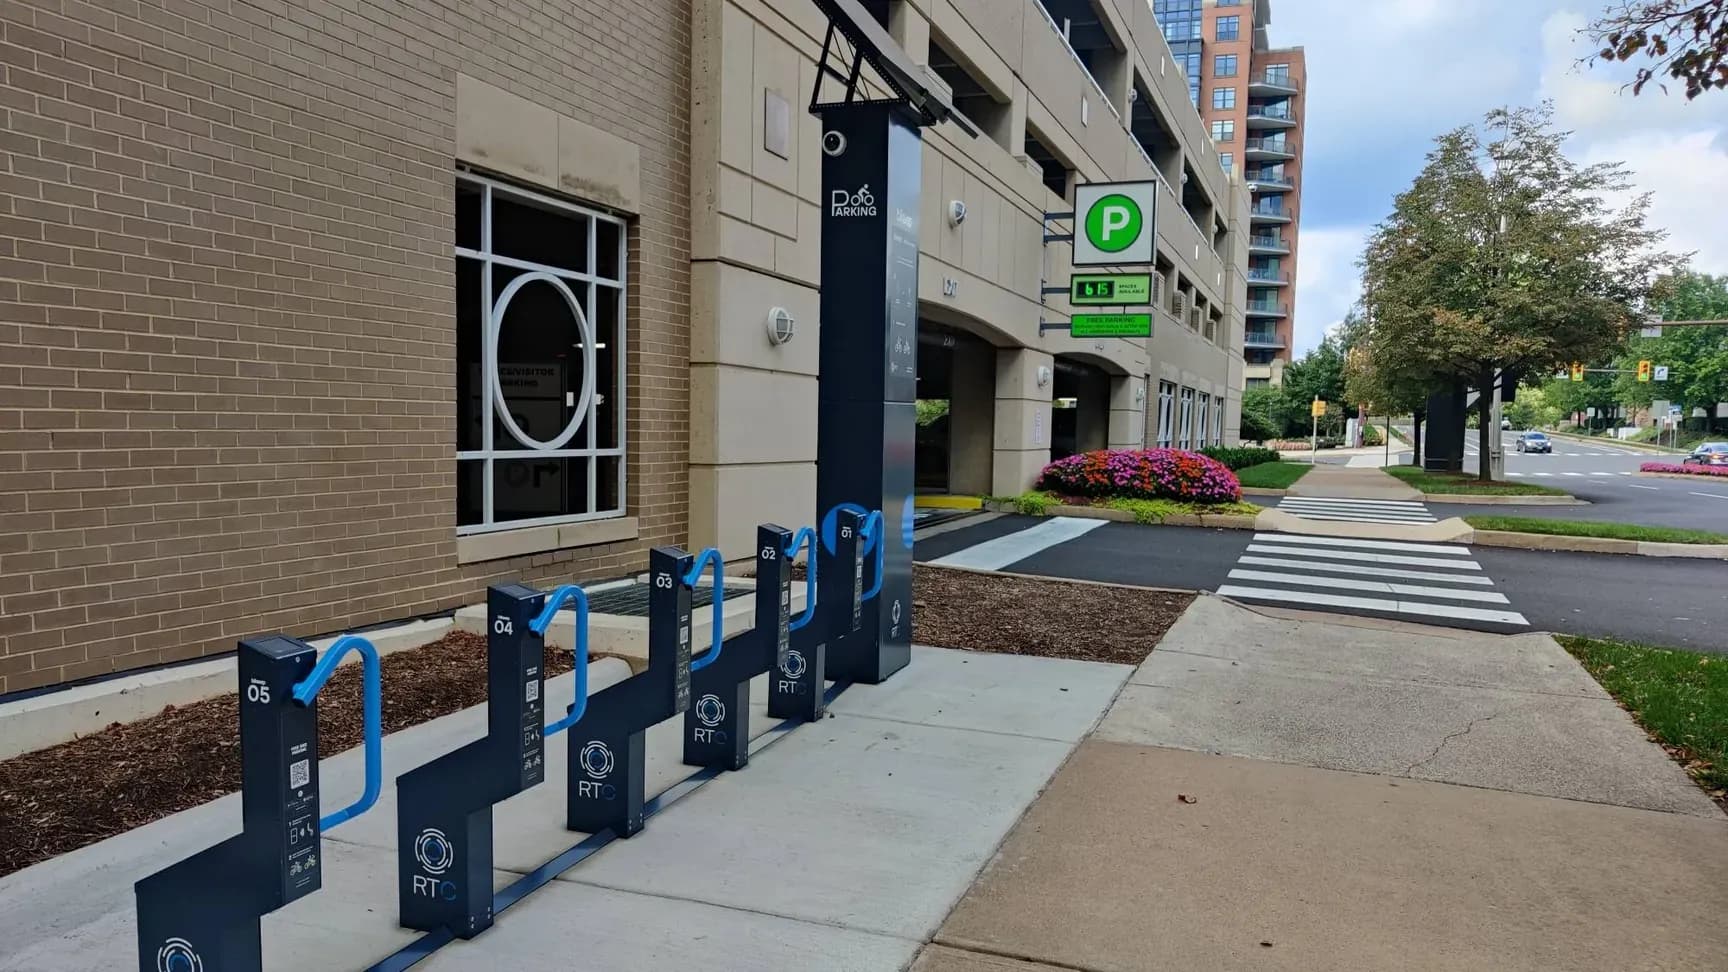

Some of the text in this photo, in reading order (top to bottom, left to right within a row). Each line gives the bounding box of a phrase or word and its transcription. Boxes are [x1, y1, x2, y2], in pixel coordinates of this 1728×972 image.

[831, 190, 877, 217] PARKING
[1102, 205, 1131, 241] P
[1085, 282, 1108, 296] 615
[841, 529, 852, 539] 01
[761, 549, 776, 560] 02
[656, 576, 673, 589] 03
[494, 620, 513, 635] 04
[248, 684, 270, 704] 05
[413, 875, 457, 901] RTC
